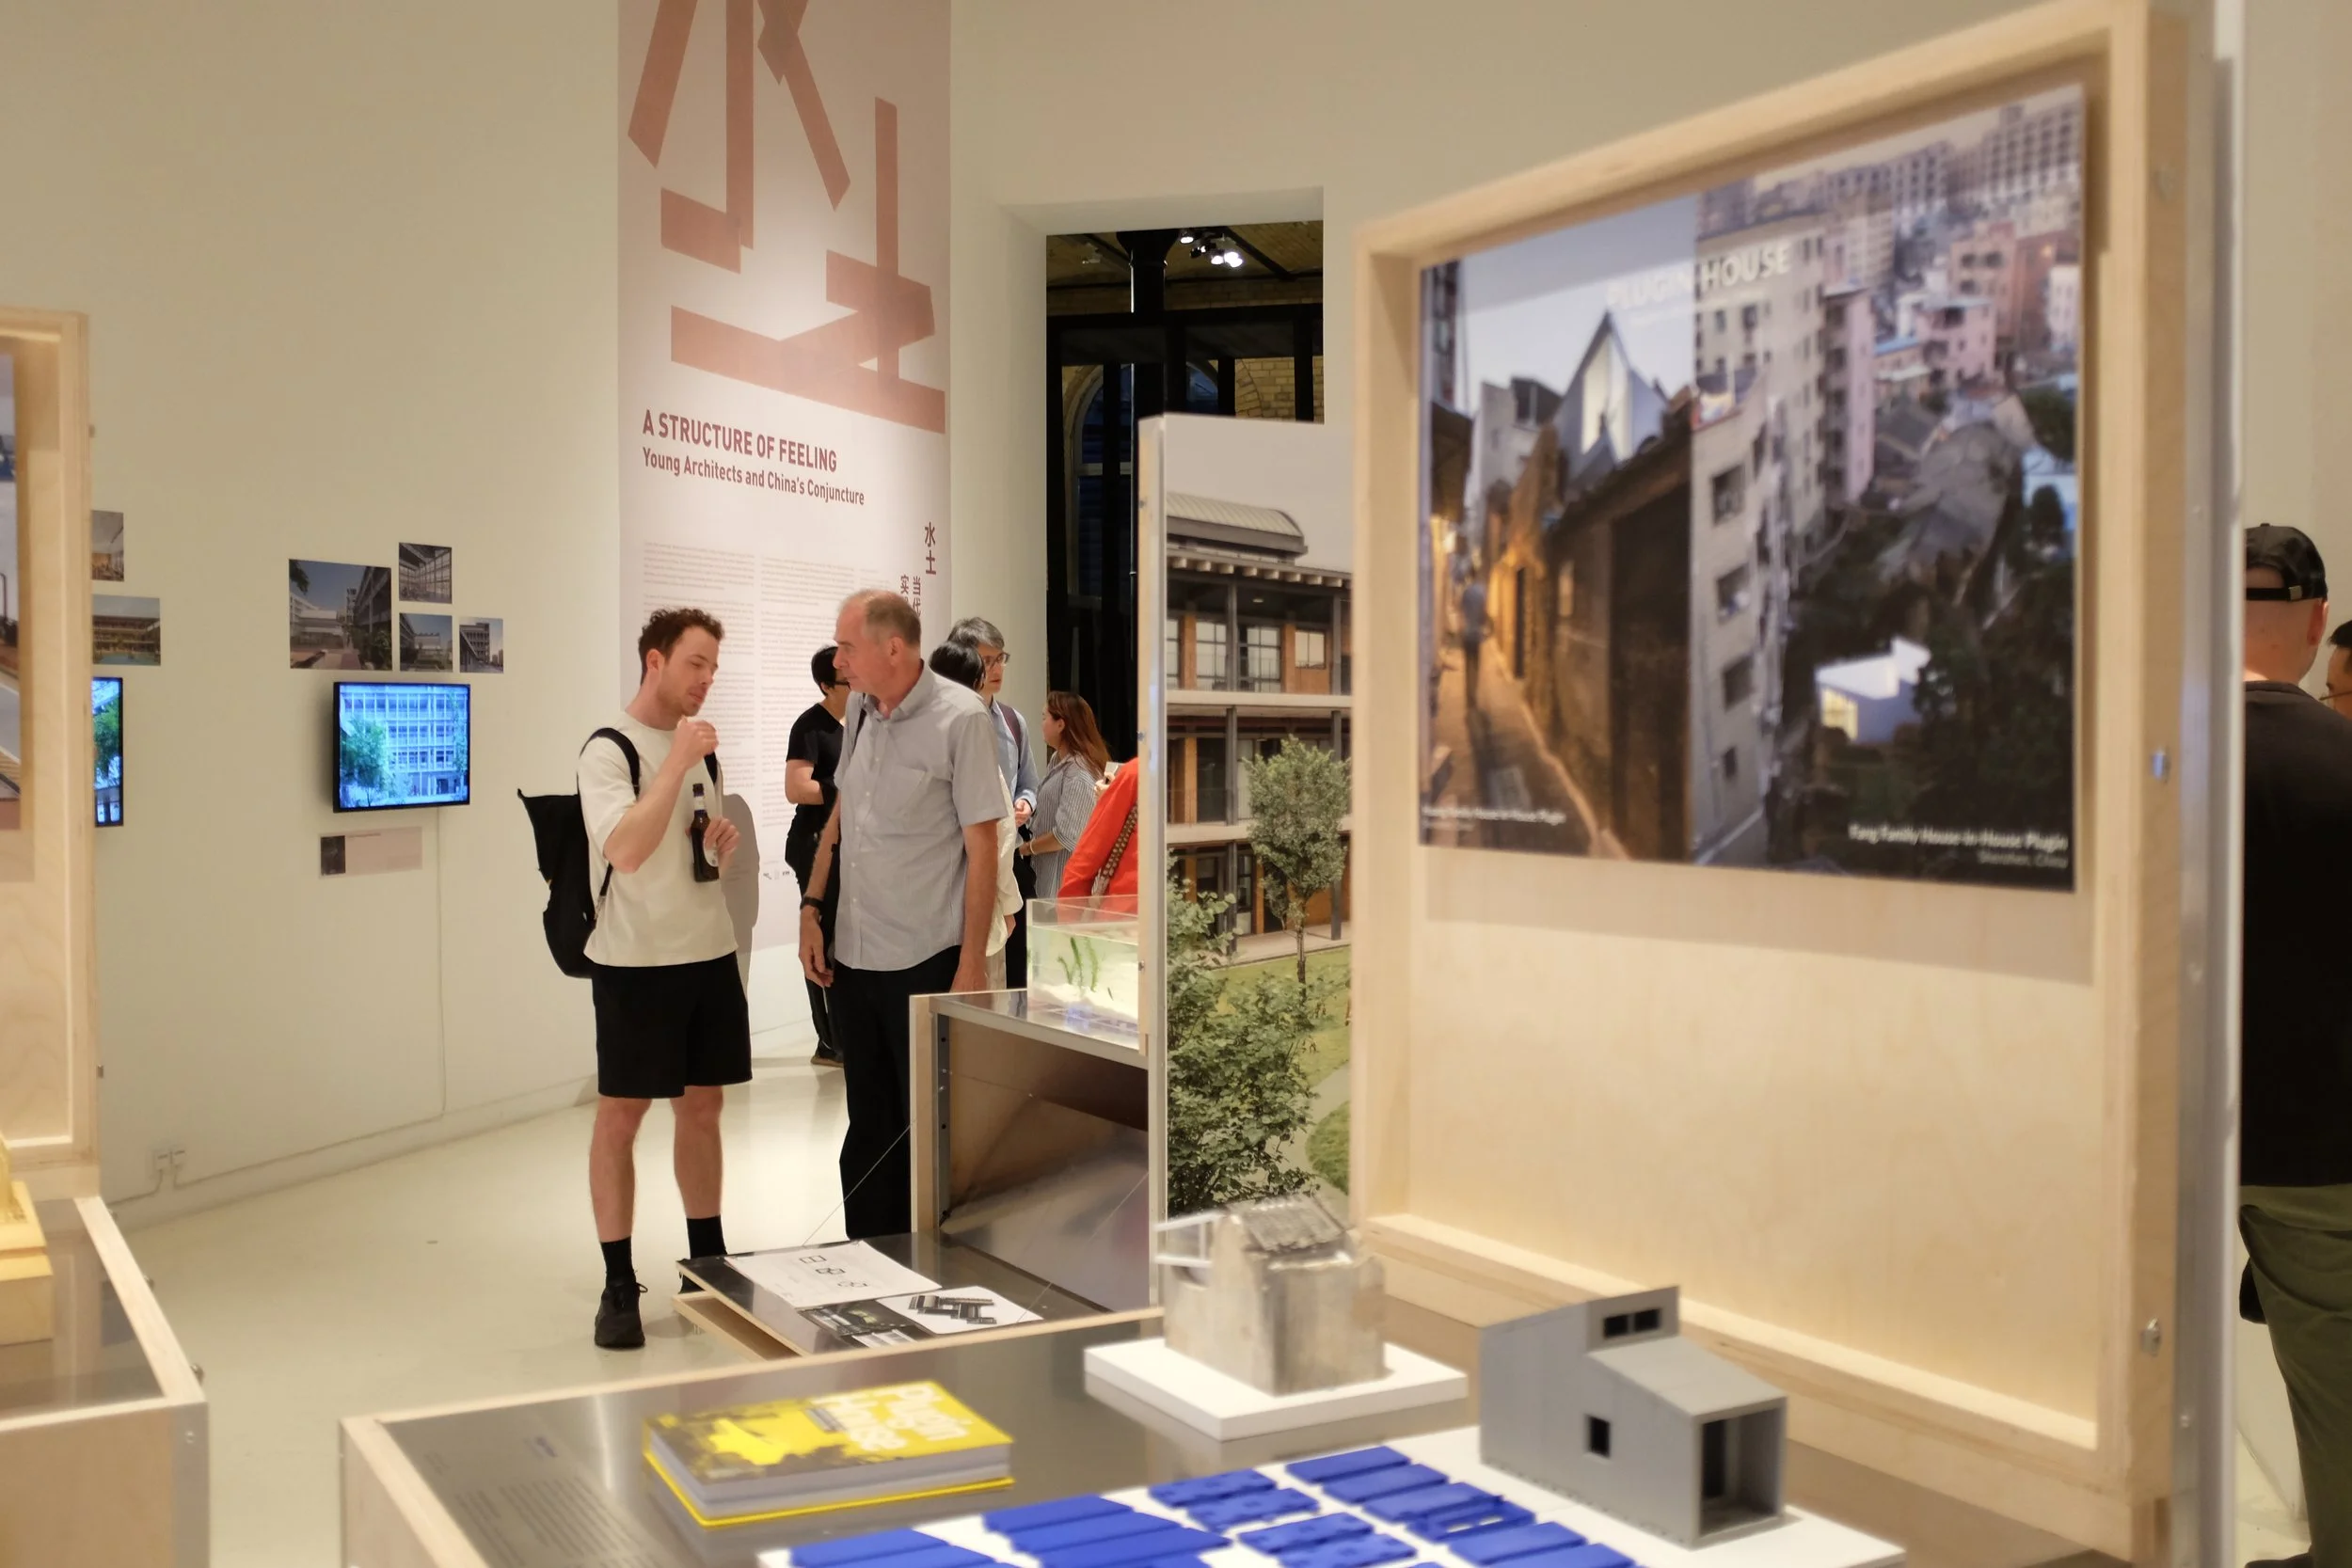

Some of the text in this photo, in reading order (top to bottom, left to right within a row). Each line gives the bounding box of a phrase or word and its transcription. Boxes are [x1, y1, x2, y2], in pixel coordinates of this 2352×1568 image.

[1701, 242, 1791, 293] HOUSE
[643, 409, 837, 472] A STRUCTURE OF FEELING
[643, 447, 865, 506] Young Architects and China's Conjuncture
[925, 521, 937, 576] 水土
[900, 574, 909, 603] 实
